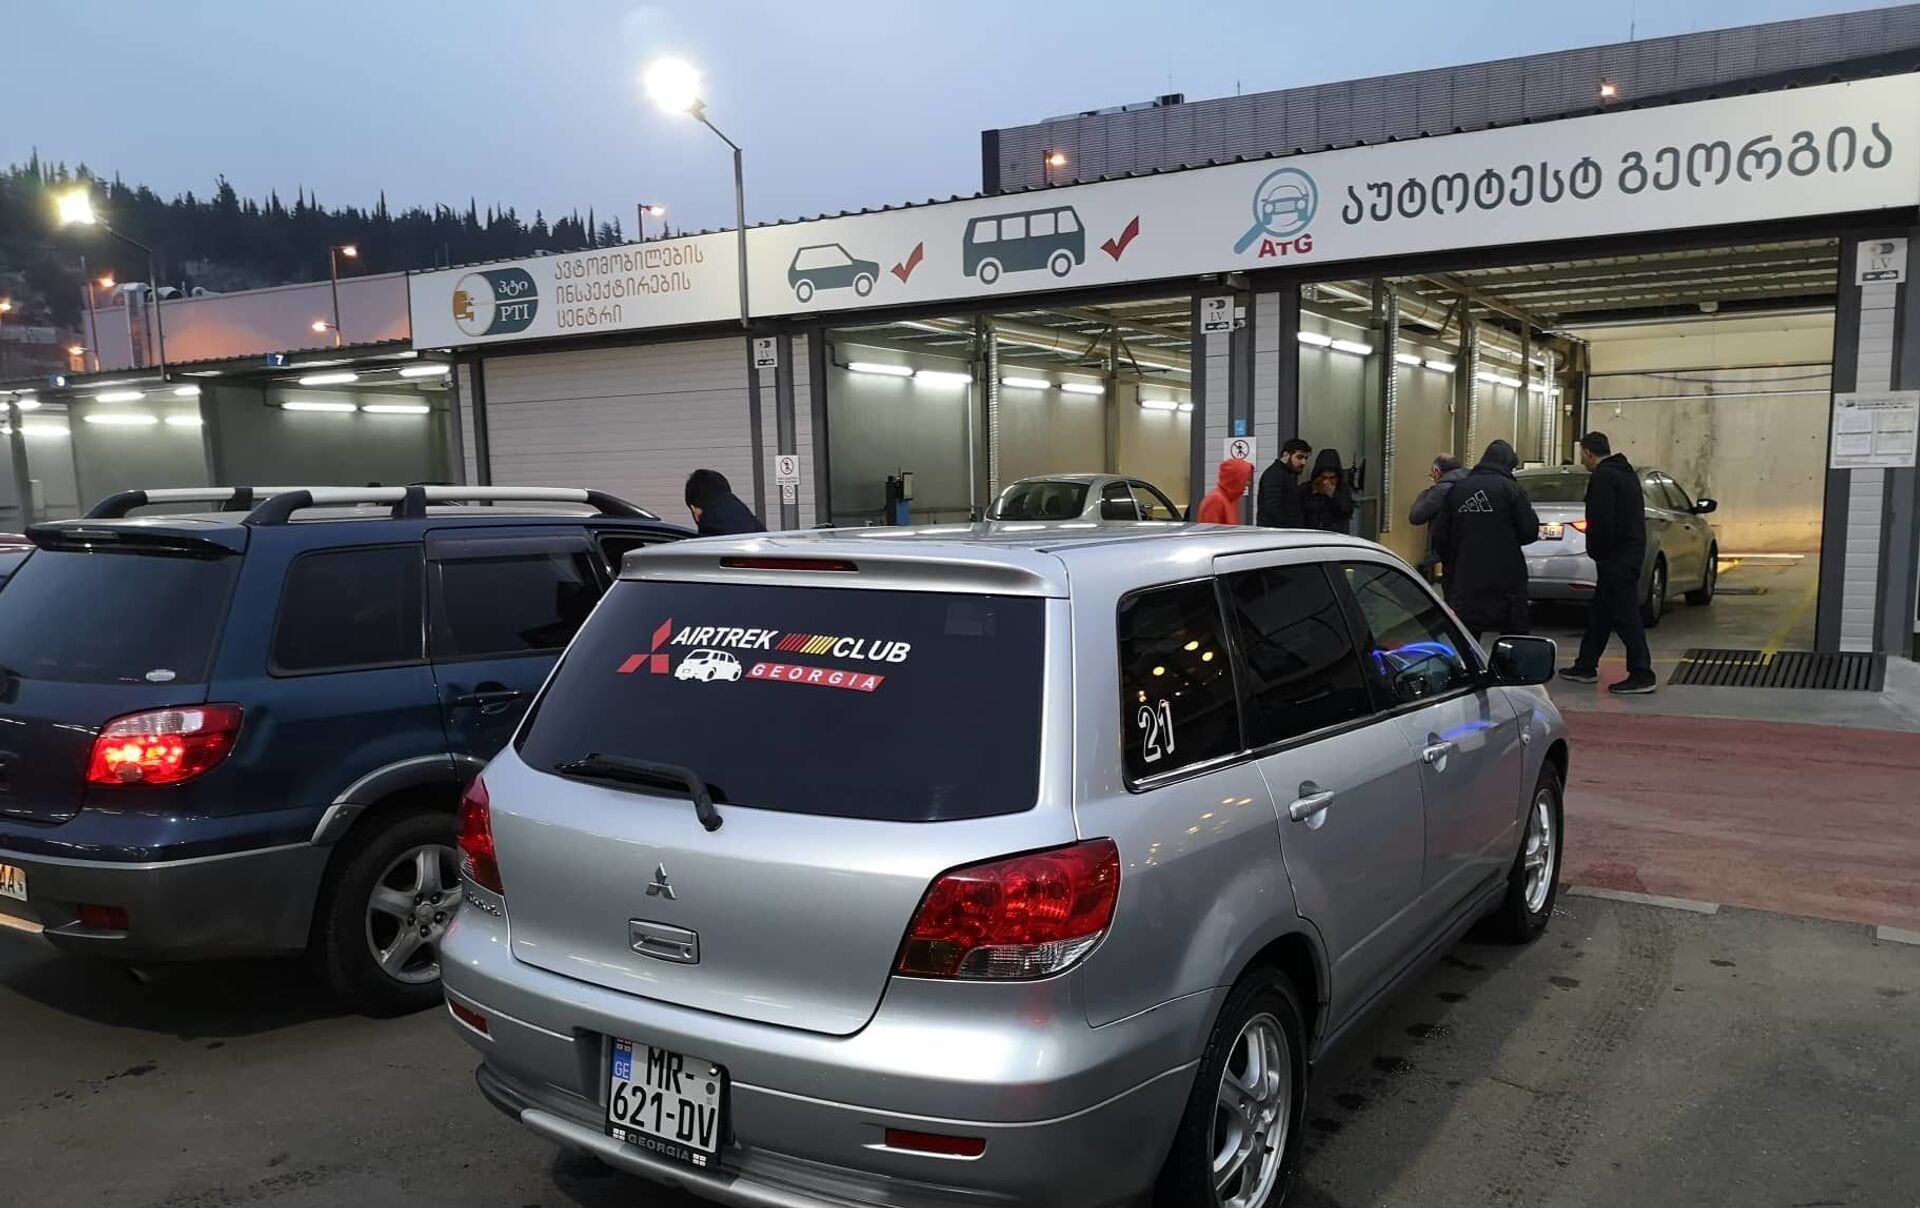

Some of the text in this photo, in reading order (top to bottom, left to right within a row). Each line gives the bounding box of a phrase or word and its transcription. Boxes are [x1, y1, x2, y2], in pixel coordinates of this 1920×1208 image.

[1342, 122, 1893, 225] აუტოტესტ გეორგია
[1258, 233, 1313, 258] ATG
[555, 244, 704, 280] ავტომობილების
[556, 272, 691, 304] ინსპექტირების
[500, 304, 529, 322] PTI
[557, 304, 622, 328] ცენტრი
[1210, 311, 1225, 321] LV
[275, 354, 284, 366] 7
[670, 626, 911, 663] AIRTREK CLUB
[751, 663, 877, 690] GEORGIA
[1137, 699, 1175, 763] 21
[614, 1061, 630, 1080] GE
[612, 1081, 716, 1149] 621-DV
[627, 1133, 691, 1162] GEORGIA
